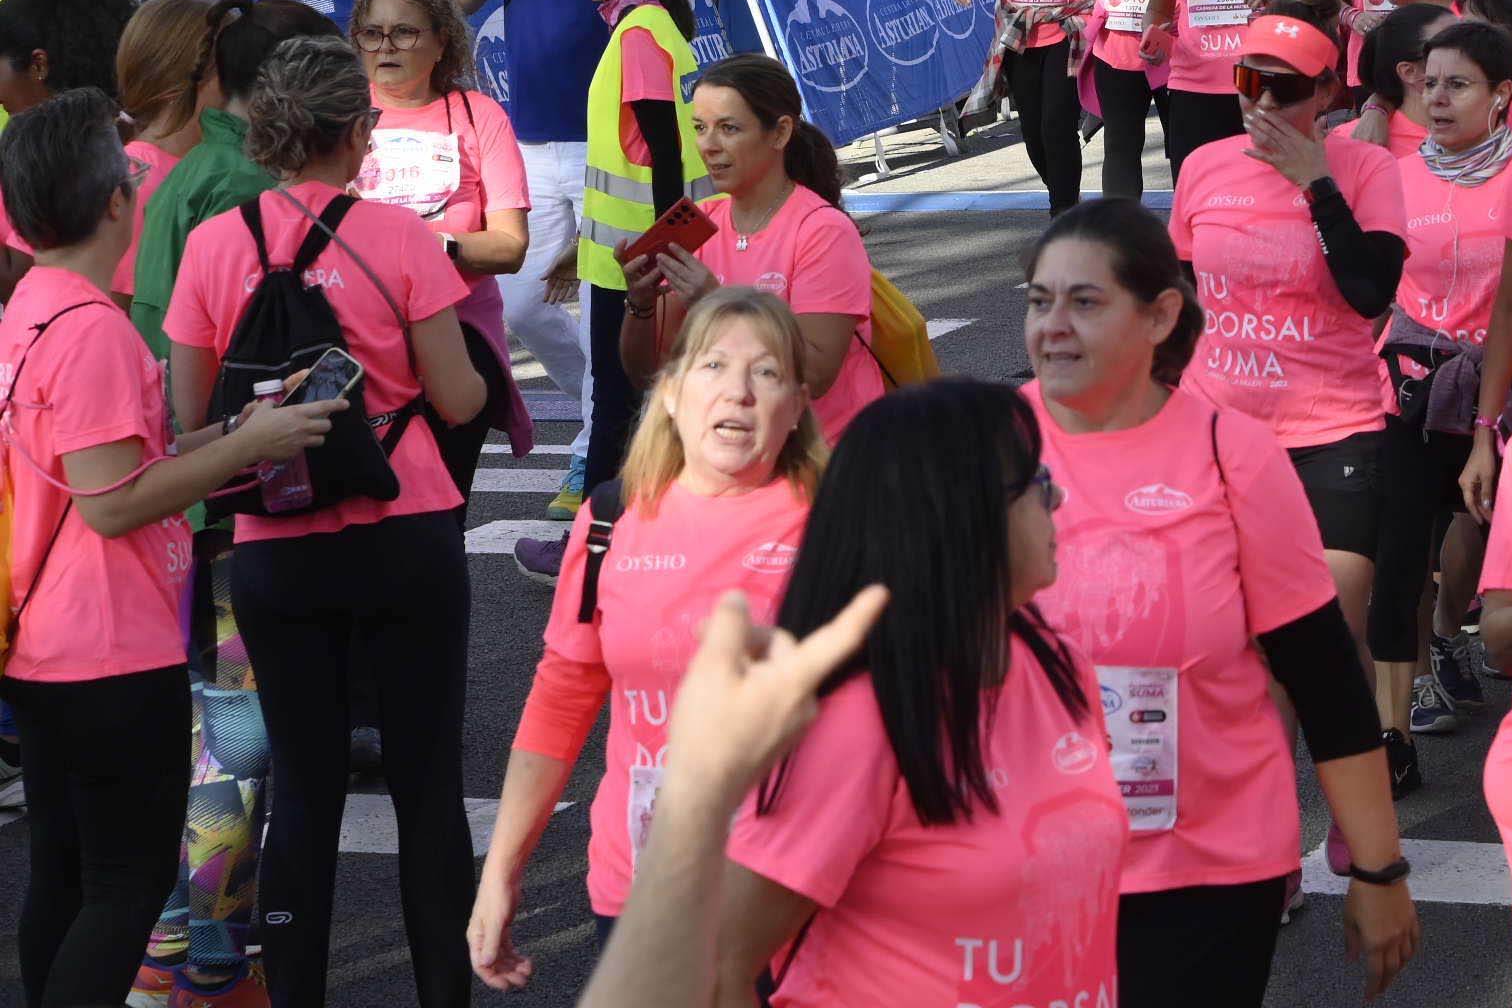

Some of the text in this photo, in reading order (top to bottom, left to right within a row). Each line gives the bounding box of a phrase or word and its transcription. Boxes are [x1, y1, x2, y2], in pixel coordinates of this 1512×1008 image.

[1208, 195, 1255, 207] OYSHO
[1408, 211, 1453, 229] OYSHO
[244, 266, 345, 293] CERA
[1199, 270, 1228, 300] TU
[1417, 296, 1449, 322] TU
[1203, 309, 1316, 343] DORSAL
[616, 552, 687, 573] OYSHO
[1128, 688, 1166, 699] SUMA
[623, 689, 669, 727] TU
[954, 936, 1025, 986] TU
